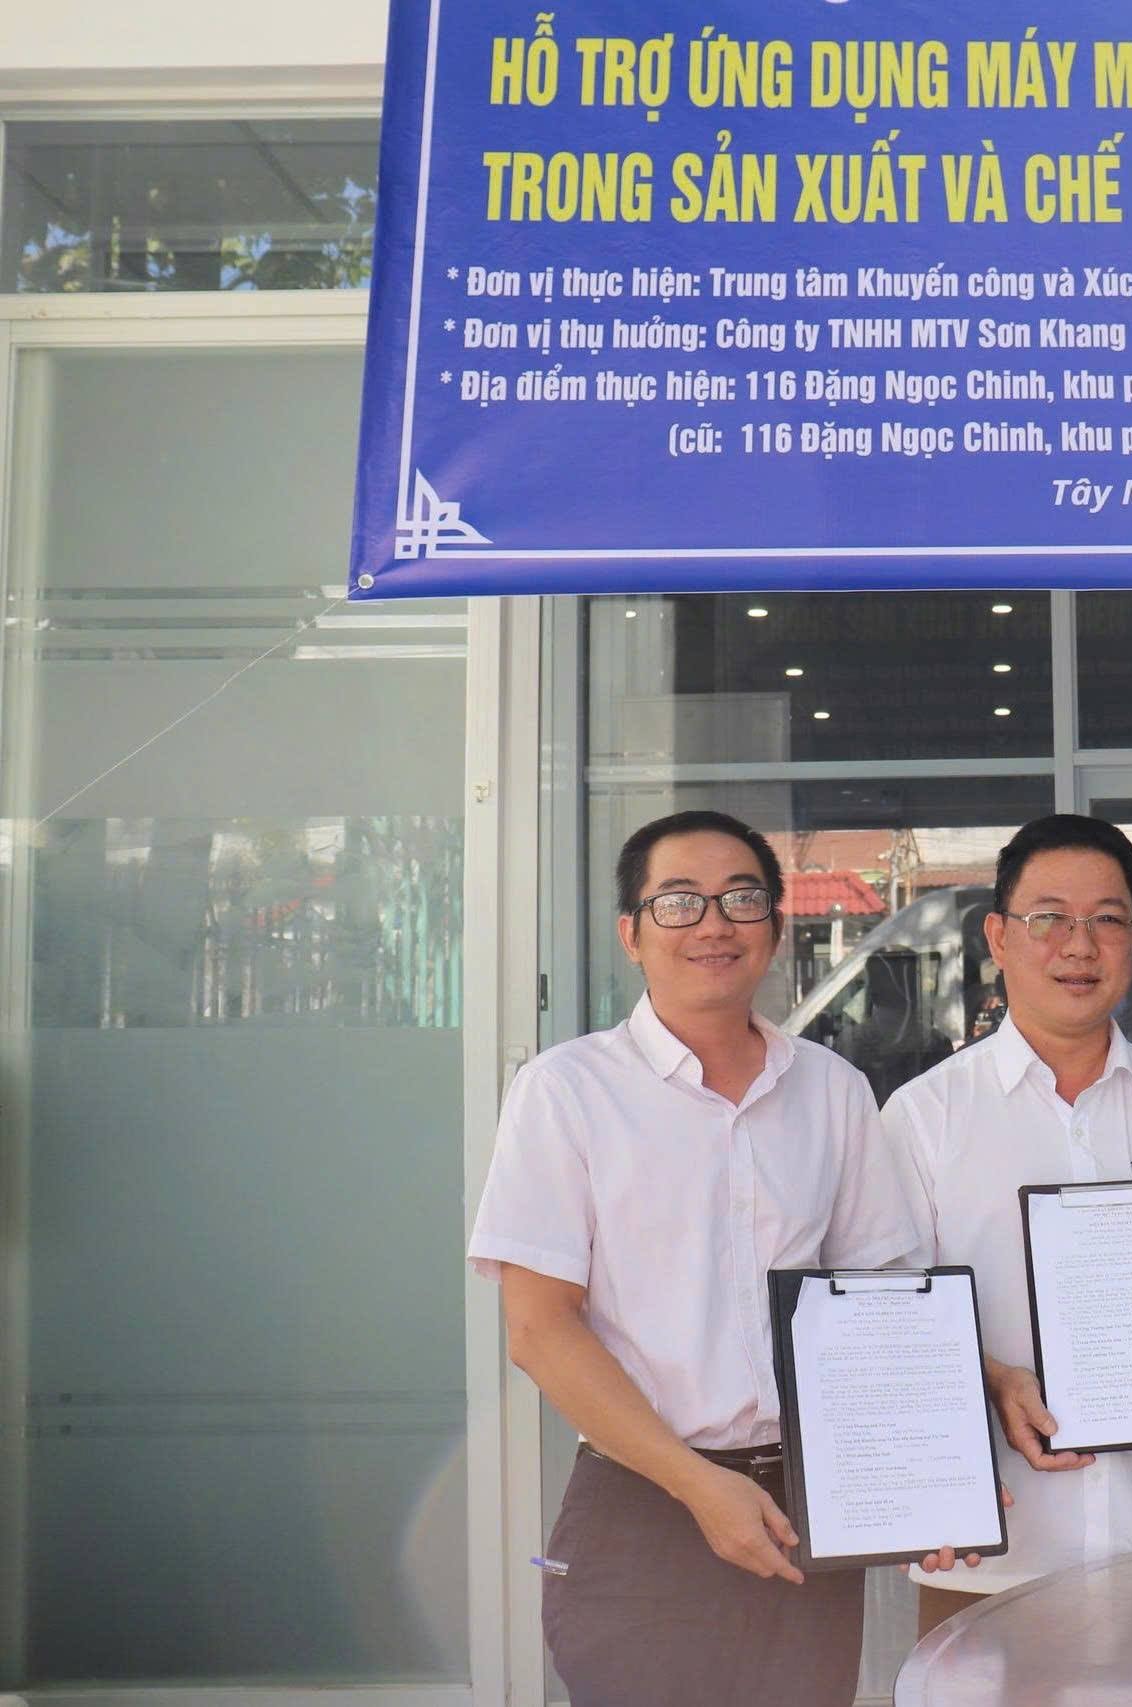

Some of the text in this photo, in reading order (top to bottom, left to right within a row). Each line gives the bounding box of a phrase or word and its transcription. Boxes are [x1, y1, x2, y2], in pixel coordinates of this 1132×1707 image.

[490, 12, 559, 107] HỖ
[576, 33, 674, 122] TRỢ
[688, 26, 793, 109] ỨNG
[810, 40, 949, 124] DỤNG
[966, 26, 1077, 108] MÁY
[483, 151, 653, 223] TRONG
[670, 129, 777, 223] SẢN
[793, 129, 927, 224] XUẤT
[941, 139, 1009, 223] VÀ
[1024, 132, 1125, 224] CHẾ
[466, 266, 521, 297] Đơn
[529, 267, 554, 303] vị
[562, 267, 623, 304] thực
[631, 266, 701, 304] hiện:
[709, 267, 787, 301] Trung
[795, 266, 848, 298] tâm
[857, 262, 959, 301] Khuyến
[967, 267, 1035, 301] công
[1042, 266, 1075, 297] và
[463, 314, 1126, 355] Đơn vị thụ hưởng: Công ty TNHH MTV Sơn Khang
[460, 370, 507, 408] Địa
[516, 363, 587, 401] điểm
[595, 370, 657, 408] thực
[666, 369, 736, 407] hiện:
[745, 370, 797, 401] 116
[804, 369, 876, 407] Đặng
[885, 370, 957, 406] Ngọc
[966, 369, 1055, 404] Chinh,
[1063, 369, 1115, 400] khu
[669, 422, 722, 457] (cũ:
[741, 422, 793, 454] 116
[800, 421, 872, 460] Đặng
[881, 422, 954, 459] Ngọc
[963, 421, 1052, 456] Chinh,
[1061, 421, 1113, 452] khu
[1052, 477, 1114, 514] Tây
